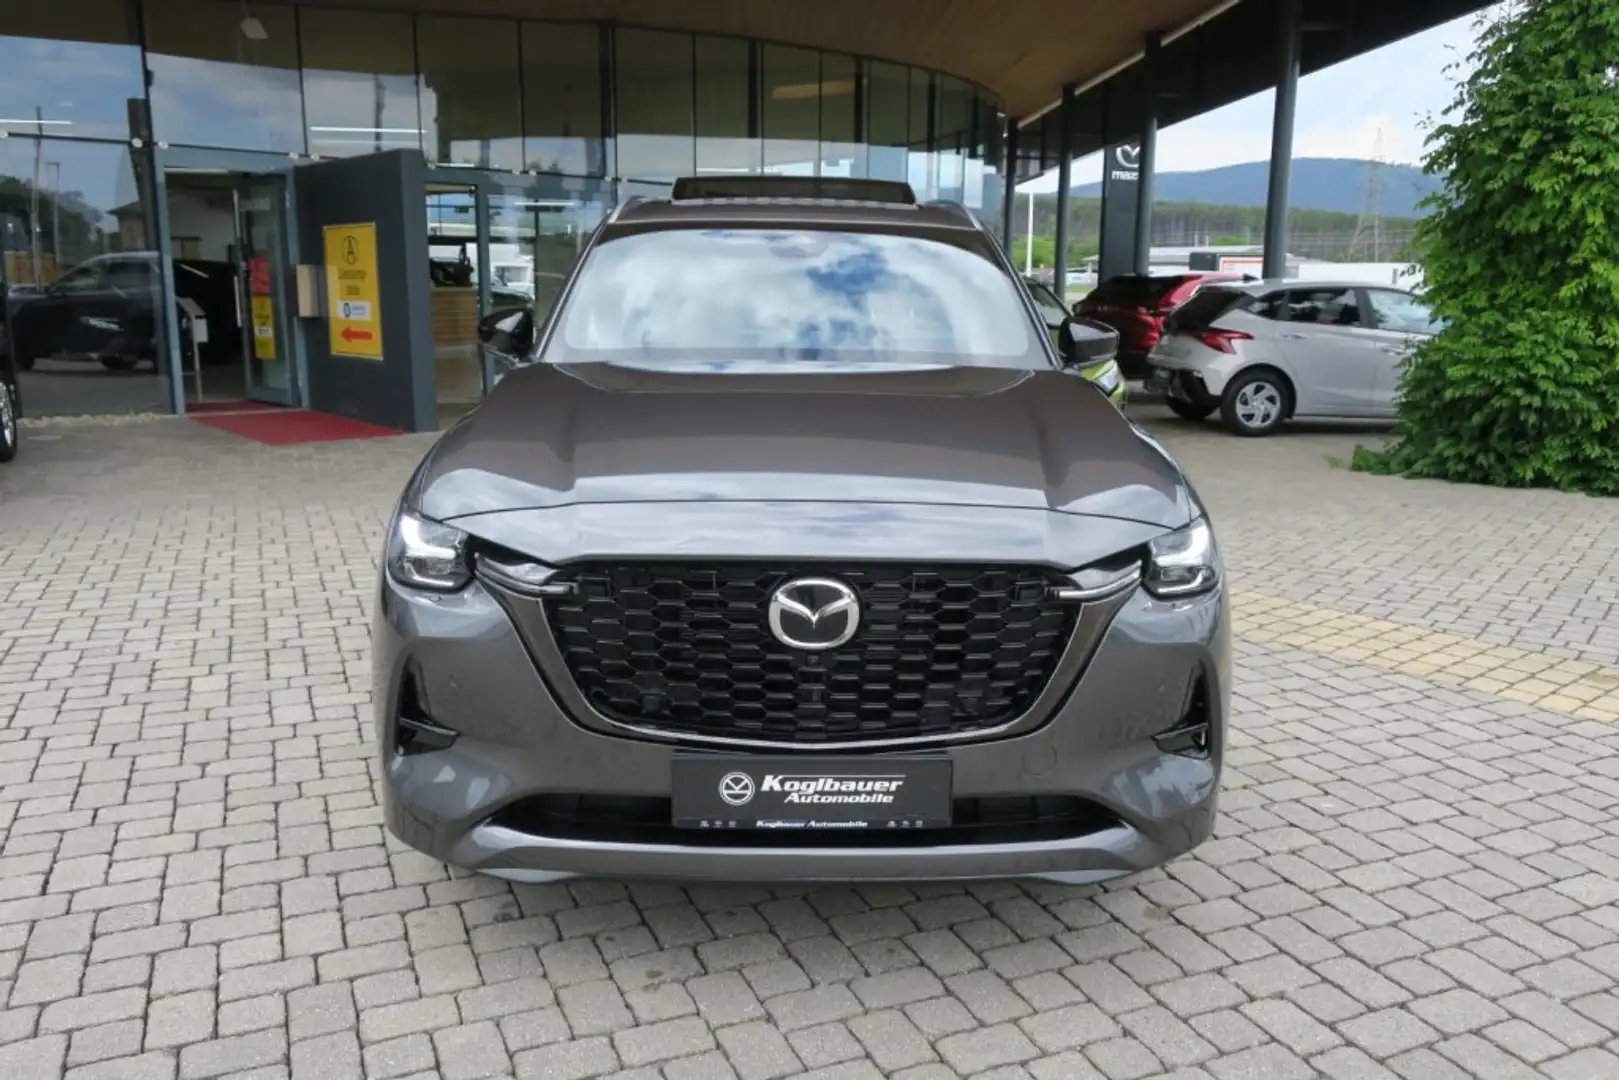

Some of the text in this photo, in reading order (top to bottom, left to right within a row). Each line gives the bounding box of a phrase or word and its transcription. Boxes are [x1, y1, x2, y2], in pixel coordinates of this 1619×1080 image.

[1111, 170, 1139, 180] maz
[761, 775, 904, 794] Koglbauer
[784, 792, 894, 804] Automobile
[756, 820, 869, 829] Koglbauer Automobile
